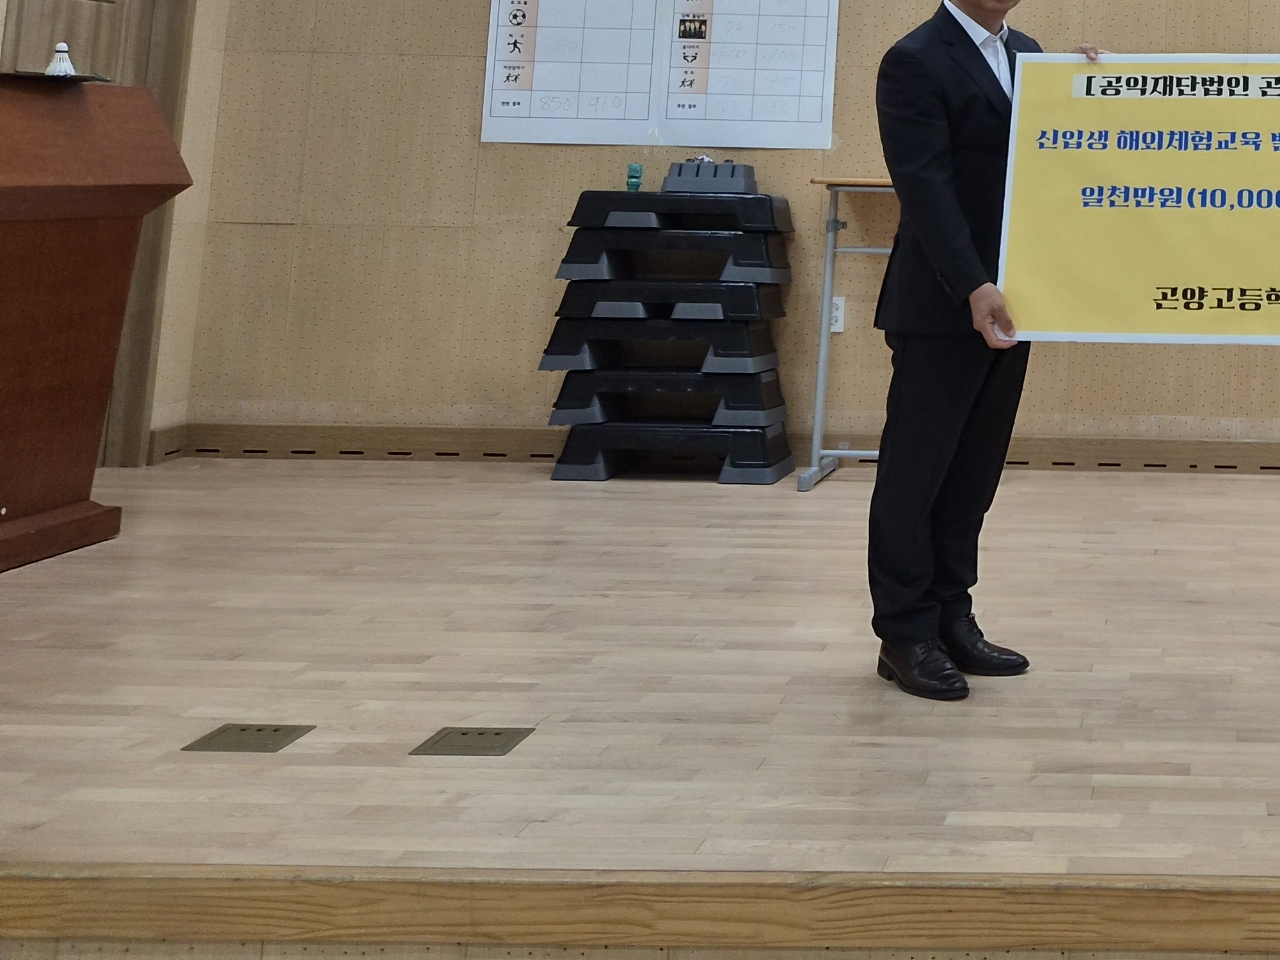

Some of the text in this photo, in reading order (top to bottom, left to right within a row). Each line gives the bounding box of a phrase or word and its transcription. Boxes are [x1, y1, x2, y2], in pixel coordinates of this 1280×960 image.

[1085, 74, 1251, 98] [공익재단법인
[539, 94, 572, 113] 850
[587, 95, 622, 115] 910
[1036, 128, 1109, 152] 신입생
[1116, 129, 1263, 153] 해외체험교육
